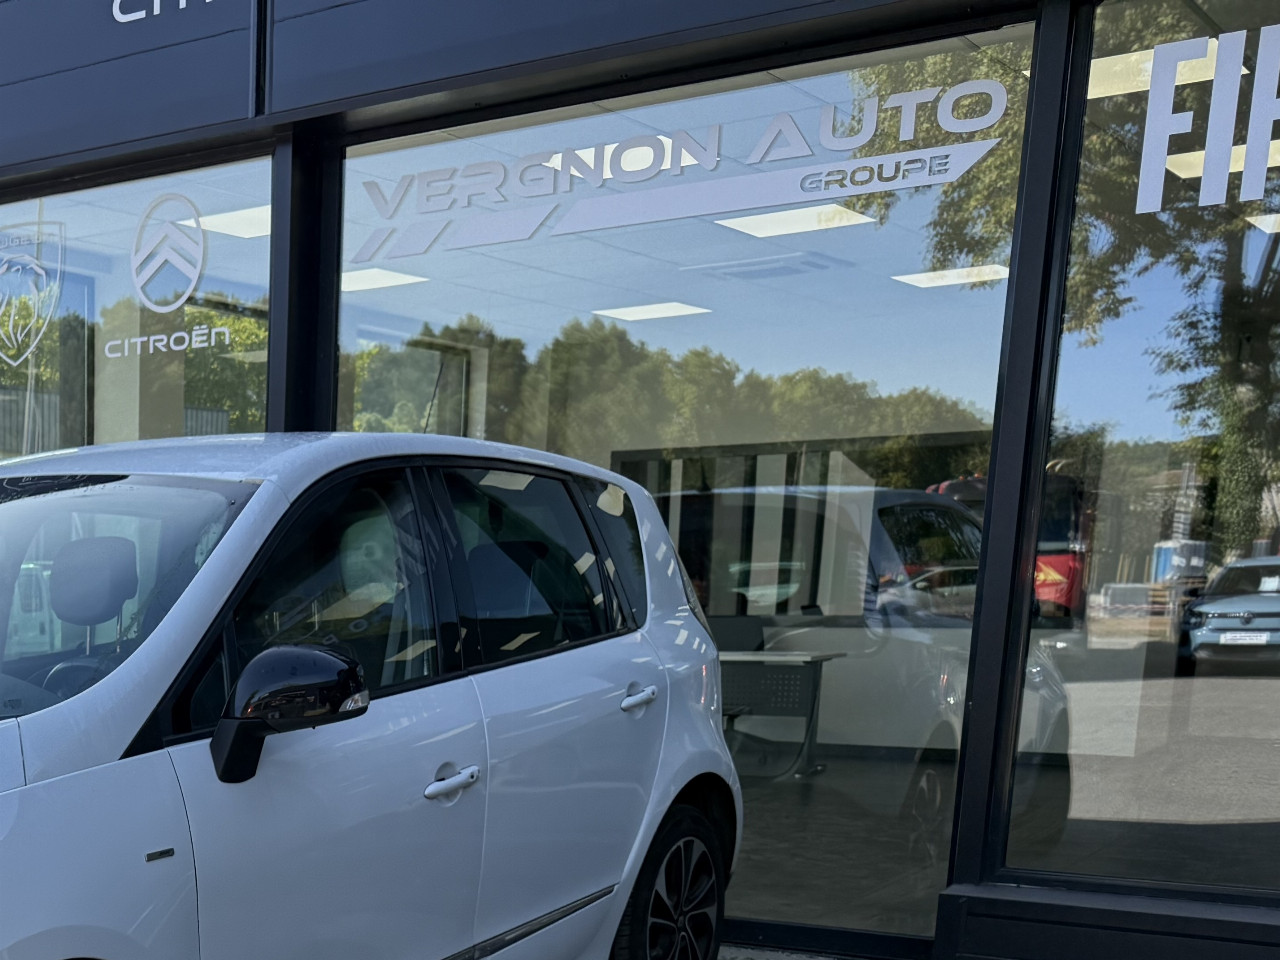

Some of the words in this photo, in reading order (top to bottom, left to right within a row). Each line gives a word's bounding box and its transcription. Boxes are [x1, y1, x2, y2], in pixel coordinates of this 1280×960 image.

[362, 124, 722, 219] VERGNON
[745, 79, 1008, 164] AUTO
[799, 154, 951, 192] GROUPE
